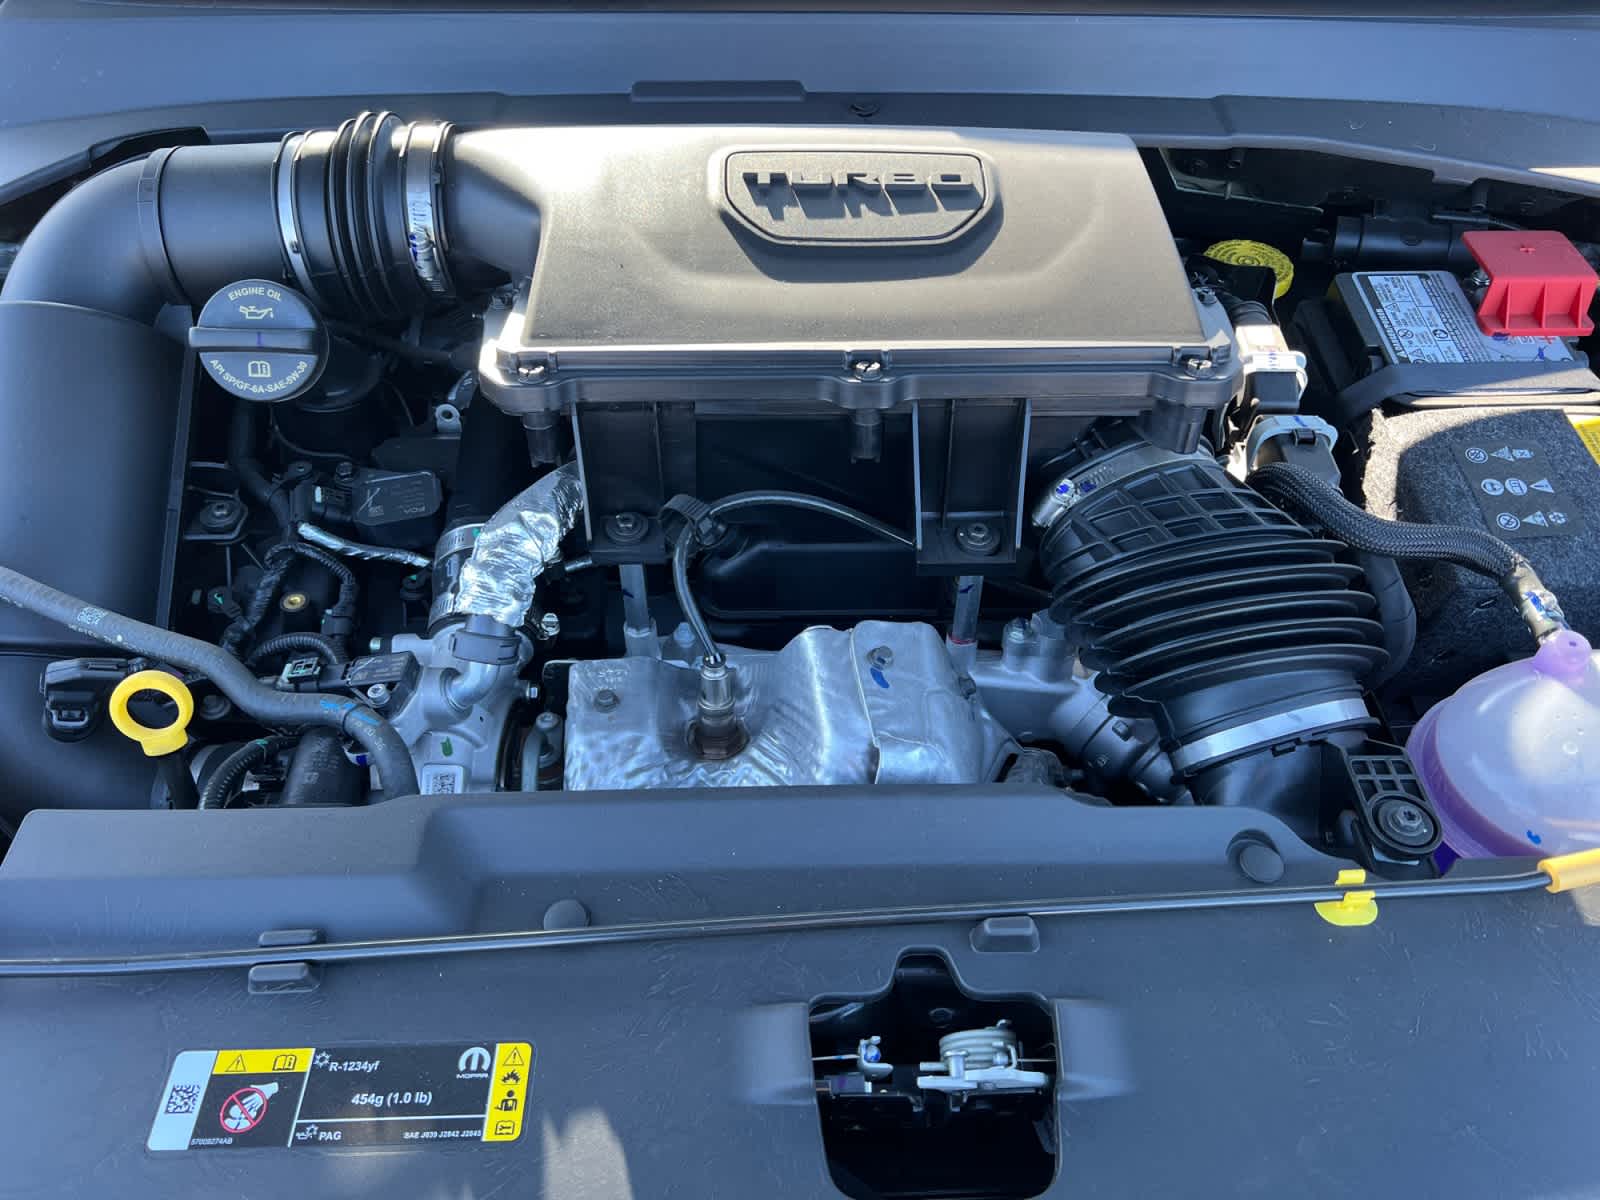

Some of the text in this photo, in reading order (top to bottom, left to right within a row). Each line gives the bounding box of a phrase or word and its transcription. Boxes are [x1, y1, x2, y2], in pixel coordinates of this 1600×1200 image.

[742, 168, 976, 194] TURBO
[228, 287, 282, 301] ENGINE OIL
[209, 359, 225, 375] API
[329, 1060, 381, 1073] R-1234yf
[351, 1091, 433, 1108] 454g (1.0 lb)
[318, 1131, 342, 1141] PAG
[403, 1131, 420, 1139] SAE
